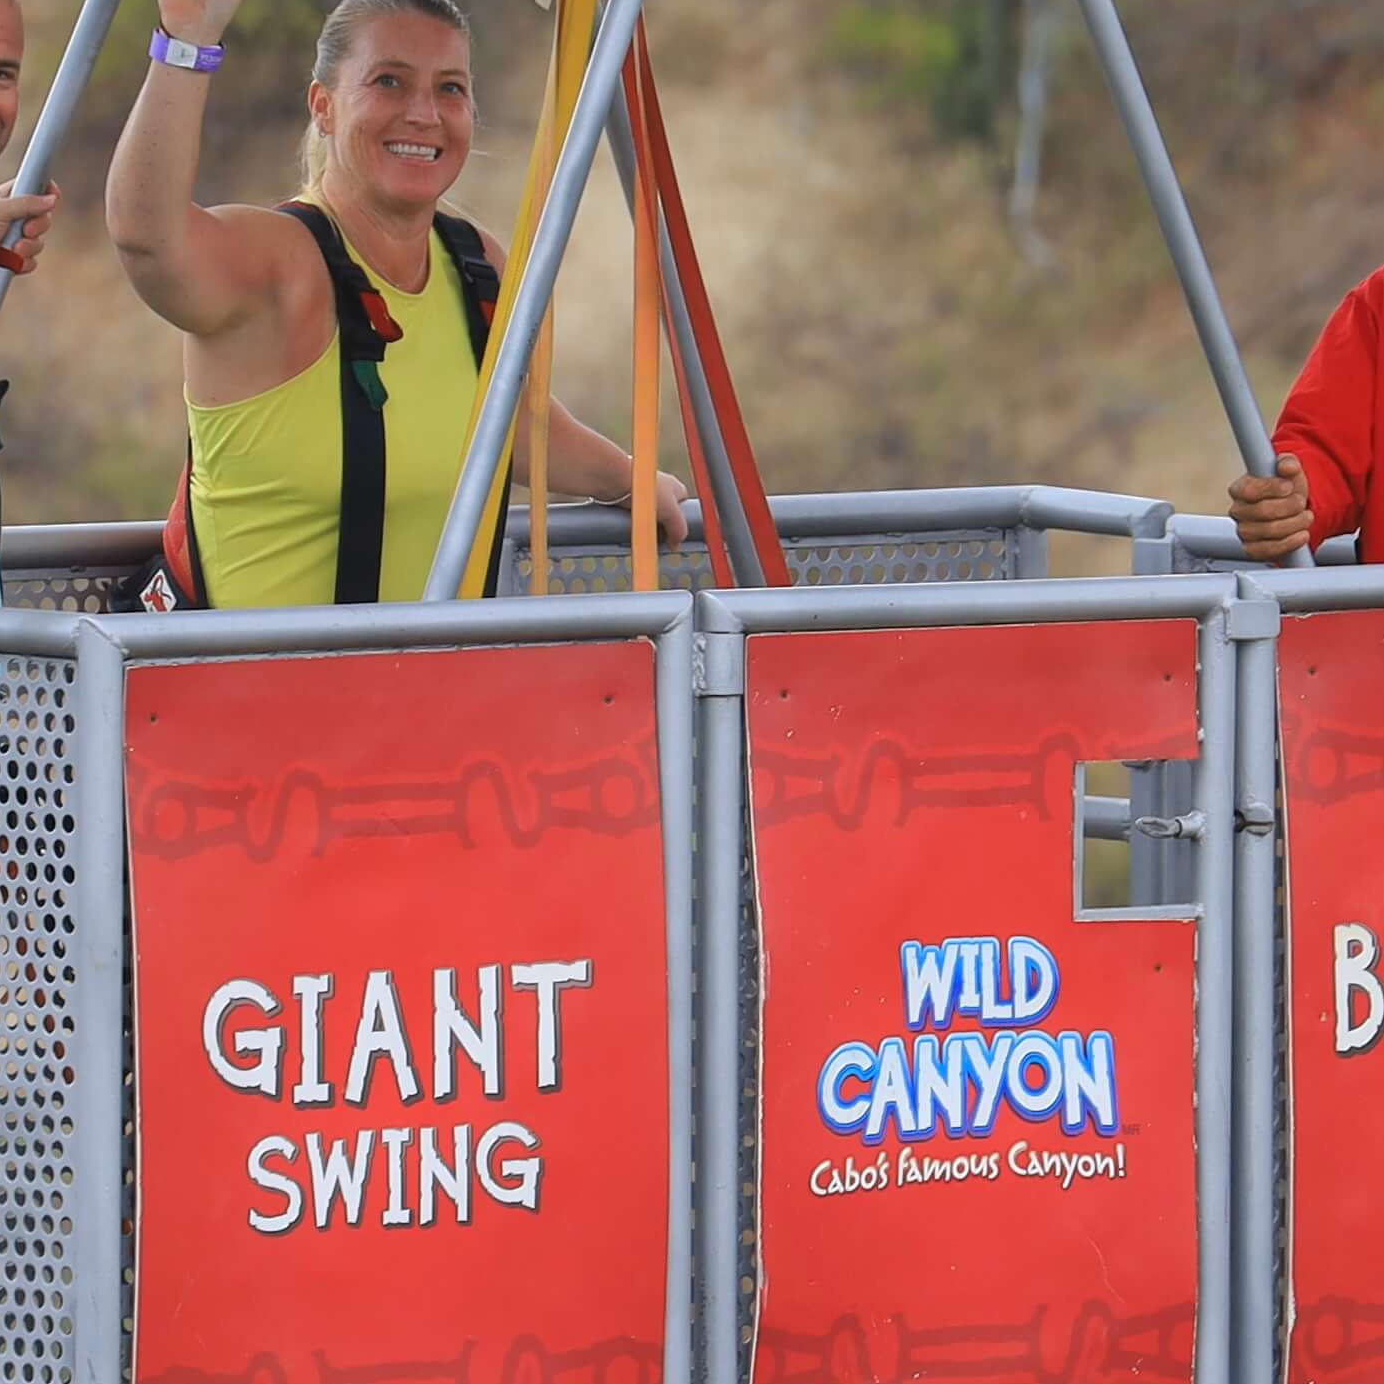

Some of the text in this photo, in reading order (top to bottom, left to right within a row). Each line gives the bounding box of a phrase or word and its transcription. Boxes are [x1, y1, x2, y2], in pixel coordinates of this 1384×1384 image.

[202, 957, 594, 1110] GIANT
[899, 935, 1060, 1031] WILD
[817, 1029, 1120, 1146] CANYON
[246, 1121, 545, 1236] SWING
[809, 1151, 890, 1197] Cabo's
[1007, 1140, 1127, 1189] Canyon!
